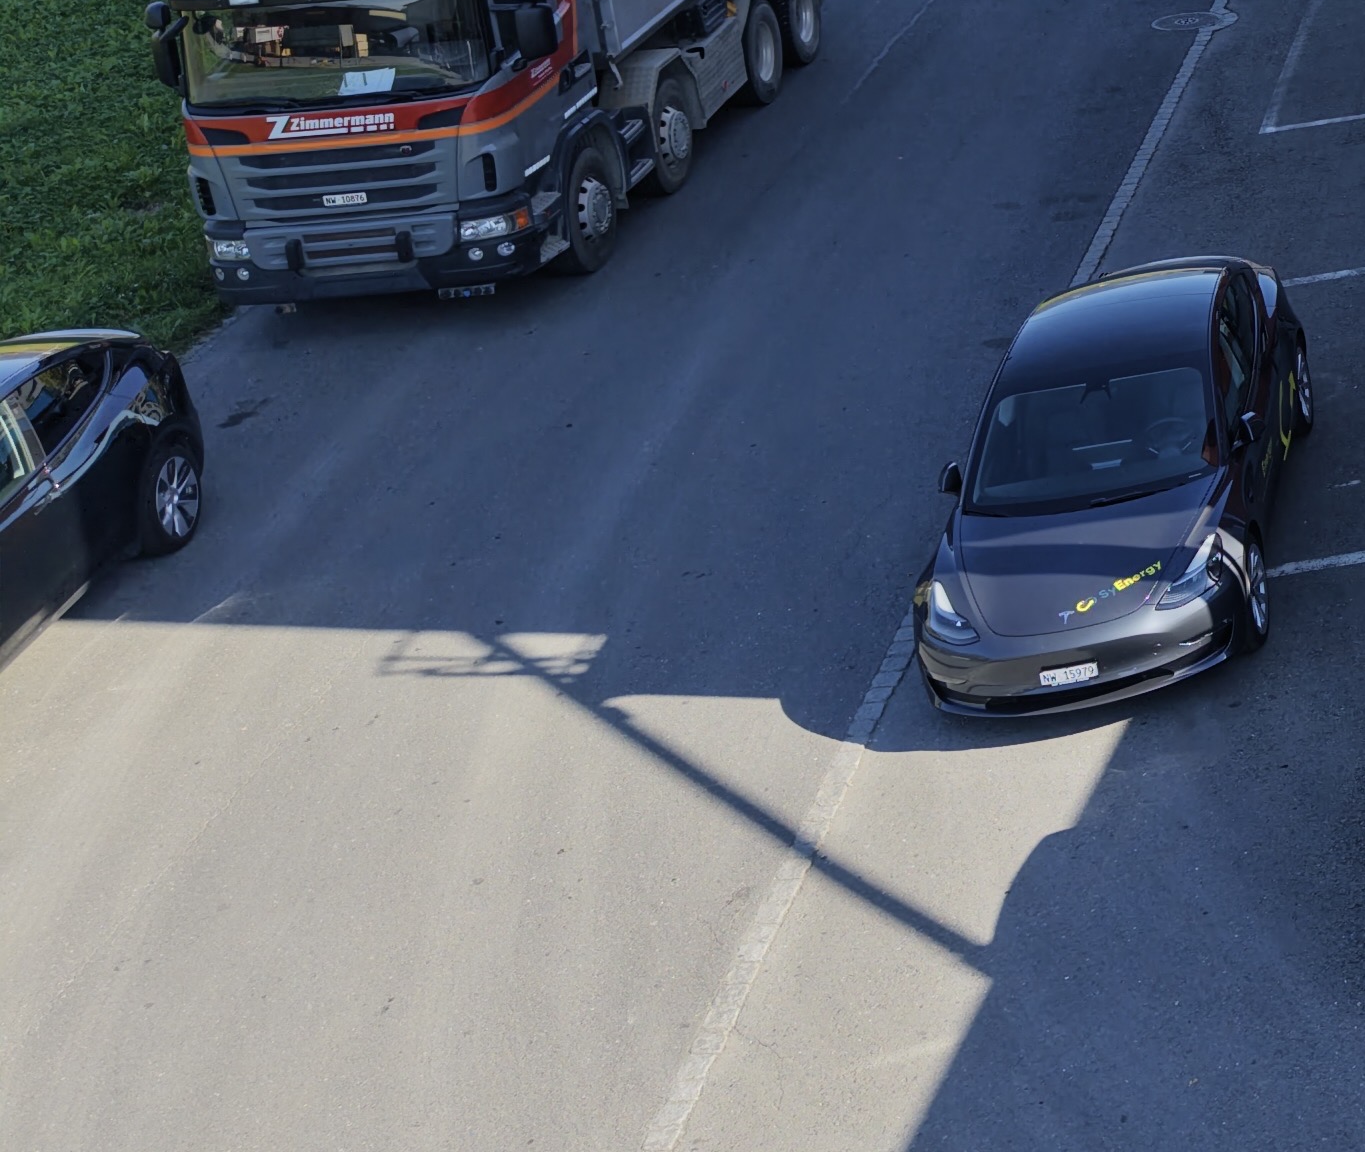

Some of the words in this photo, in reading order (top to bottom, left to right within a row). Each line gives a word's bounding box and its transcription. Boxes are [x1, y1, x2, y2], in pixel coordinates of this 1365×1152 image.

[290, 112, 395, 131] Zimmermann
[325, 196, 337, 205] NW
[341, 193, 365, 204] 10876
[1042, 673, 1057, 683] NW
[1064, 665, 1094, 680] 15979
